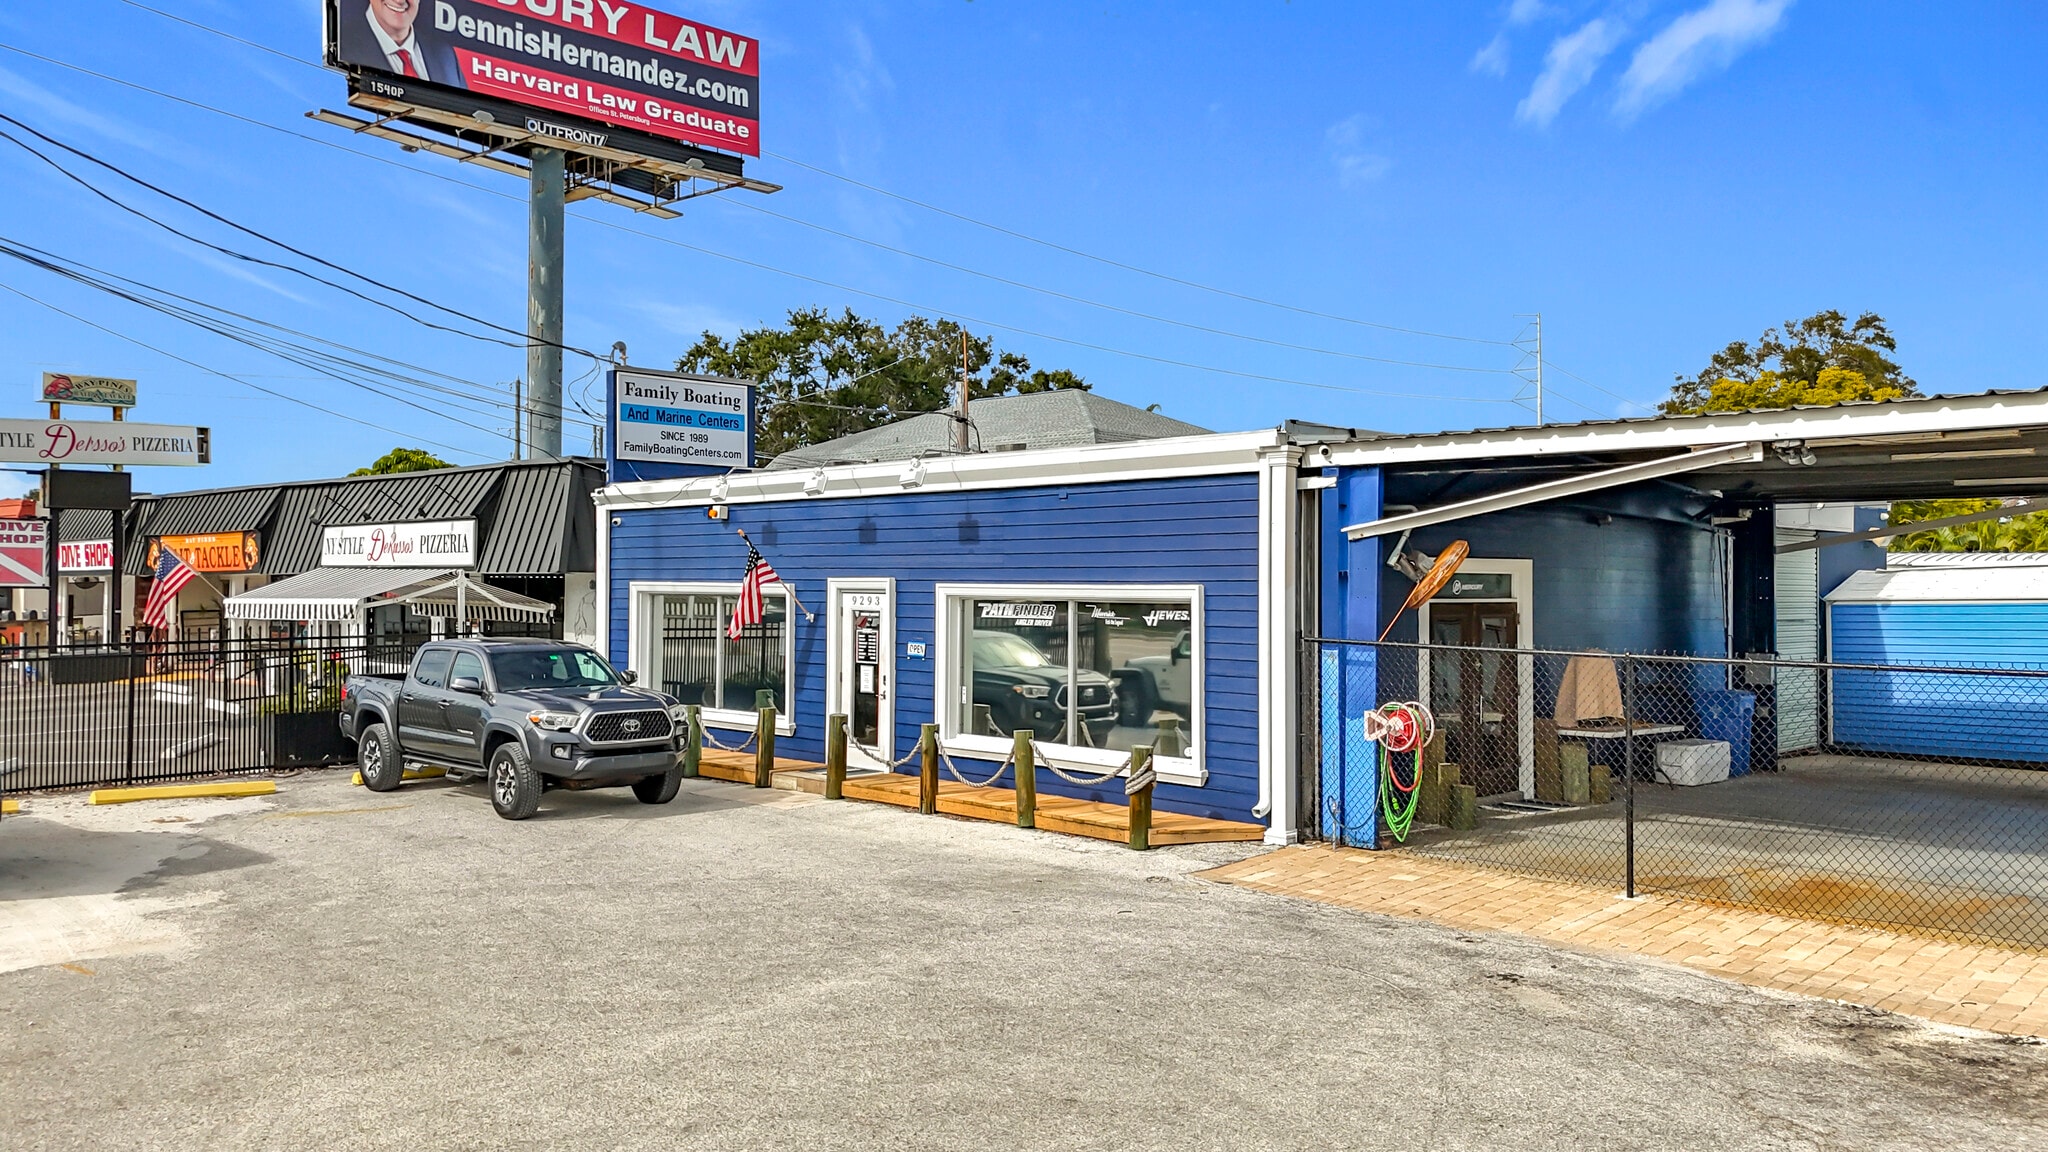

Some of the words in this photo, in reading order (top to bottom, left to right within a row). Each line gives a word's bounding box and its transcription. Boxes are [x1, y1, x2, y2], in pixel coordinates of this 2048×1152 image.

[644, 13, 748, 69] LAW
[434, 0, 750, 108] DennisHernandez.com
[370, 81, 405, 98] 1540P
[471, 56, 580, 100] Harvard
[587, 85, 637, 112] Law
[644, 100, 750, 138] Graduate
[588, 105, 610, 116] Offices
[619, 112, 651, 126] Petersburg
[75, 380, 95, 390] BAY
[99, 379, 130, 393] PINES
[624, 381, 679, 405] Family
[683, 388, 742, 412] Boating
[627, 407, 650, 421] And
[656, 409, 693, 425] Marine
[698, 413, 740, 429] Centers
[132, 436, 194, 453] PIZZERIA
[660, 430, 686, 442] SINCE
[689, 433, 709, 444] 1989
[623, 441, 742, 460] FamilyBoatingCenters.com
[324, 537, 338, 556] NY
[337, 536, 366, 556] STYLE
[419, 533, 469, 554] PIZZERIA
[61, 544, 82, 569] DIVE
[84, 542, 109, 568] SHOP
[194, 545, 240, 569] TACKLE
[852, 596, 880, 606] 9293
[978, 603, 1057, 619] PATHFINDER
[909, 644, 925, 654] OPEN
